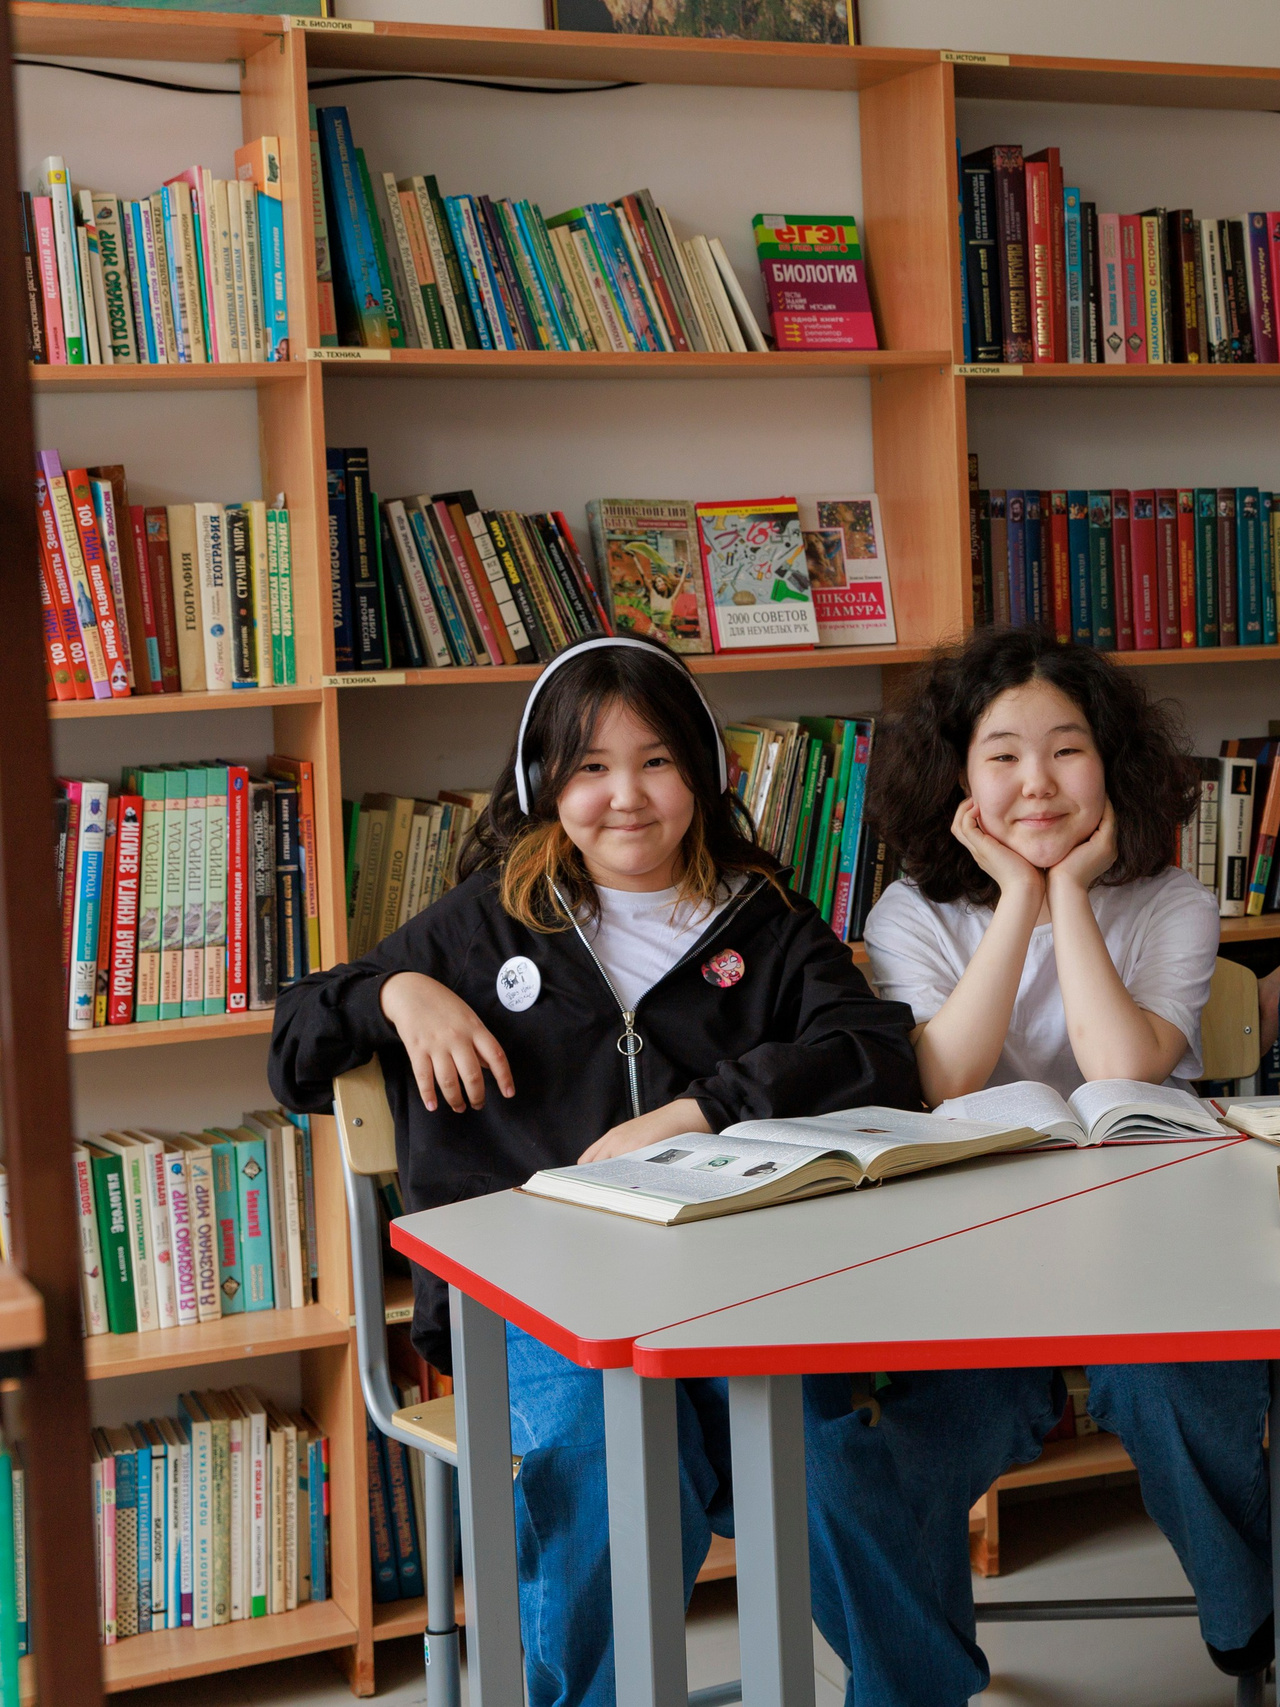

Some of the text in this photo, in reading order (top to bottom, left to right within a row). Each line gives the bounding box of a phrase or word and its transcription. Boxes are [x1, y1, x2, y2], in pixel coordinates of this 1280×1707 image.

[309, 20, 352, 29] БИОЛОГИЯ
[153, 207, 162, 234] КАРТЕ
[979, 174, 988, 238] ЦИВИЛИЗАЦИИ
[41, 227, 55, 298] ЦЕЛЕБНЫЙ МЕД
[158, 245, 167, 286] ПОВЕСТЬ
[223, 247, 232, 281] ОКЕАНАМ
[234, 249, 244, 283] ОКЕАНАМ
[272, 227, 283, 300] МЕГА ГЕОГРАФИЯ
[772, 264, 857, 283] БИОЛОГИЯ
[1146, 221, 1156, 275] ИСТОРИЕЙ
[98, 230, 130, 356] Я ПОЗНАЮ МИР
[182, 214, 201, 345] ЗА СТРАНИЦАМИ УЧЕБНИКА ГЕОГРАФИИ
[382, 289, 397, 321] 1600
[1007, 244, 1027, 333] РУССКАЯ ИСТОРИЯ
[226, 292, 236, 335] МАТЕРИКАМ
[237, 294, 247, 337] МАТЕРИКАМ
[1150, 289, 1160, 360] ЗНАКОМСТВО
[230, 338, 238, 349] ПО
[240, 340, 247, 350] ПО
[55, 494, 85, 577] ВСЕЛЕННАЯ
[602, 506, 687, 517] ЭНЦИКЛОПЕДИЯ
[605, 519, 633, 528] БЫТА
[211, 516, 223, 587] ГЕОГРАФИЯ
[267, 521, 280, 636] ФИЗИЧЕСКАЯ ГЕОГРАФИЯ
[279, 523, 291, 637] ФИЗИЧЕСКАЯ ГЕОГРАФИЯ
[329, 515, 344, 628] ИНФОРМАТИКА
[489, 521, 521, 585] ВЯЖЕМ САМИ
[42, 510, 86, 664] 100 ТАЙН планеты Земля
[77, 504, 118, 659] 100 ТАЙН планеты Земля
[182, 553, 196, 631] ГЕОГРАФИЯ
[234, 521, 249, 672] СПРАВОЧНИК СТРАНЫ МИРА
[414, 571, 440, 635] ХОЧУ ВСЕ ЗНАТЬ
[457, 556, 483, 613] ТЕХНОЛОГИЯ
[816, 592, 877, 604] ШКОЛА
[42, 610, 59, 641] ТАЙН
[360, 596, 371, 652] ПРОФЕССИИ
[368, 608, 377, 639] ВЫБОР
[728, 610, 807, 625] 2000 СОВЕТОВ
[729, 624, 810, 637] ДЛЯ НЕУМЕЛЫХ РУК
[53, 643, 67, 665] 100
[264, 658, 270, 668] ПО
[281, 799, 289, 822] ЗВЕРИ
[144, 822, 161, 895] ПРИРОДА
[166, 821, 182, 893] ПРИРОДА
[187, 820, 203, 891] ПРИРОДА
[208, 817, 224, 889] ПРИРОДА
[254, 810, 265, 896] МИР ЖИВОТНЫХ
[283, 833, 291, 860] ПТИЦЫ
[392, 851, 404, 882] ДЕЛО
[115, 822, 140, 996] КРАСНАЯ КНИГА ЗЕМЛИ
[234, 872, 242, 940] ЭНЦИКЛОПЕДИЯ
[835, 881, 850, 935] СУМКИ
[234, 942, 242, 983] БОЛЬШАЯ
[80, 1161, 92, 1215] ЗООЛОГИЯ
[155, 1153, 167, 1206] БОТАНИКА
[172, 1190, 196, 1310] Я ПОЗНАЮ МИР
[196, 1185, 215, 1305] Я ПОЗНАЮ МИР
[199, 1453, 208, 1525] ПОДРОСТКА
[140, 1493, 151, 1620] ОХРАНА ПРИРОДЫ
[154, 1518, 162, 1563] ЭКОЛОГИЯ
[200, 1538, 209, 1619] ВАЛЕОЛОГИЯ
